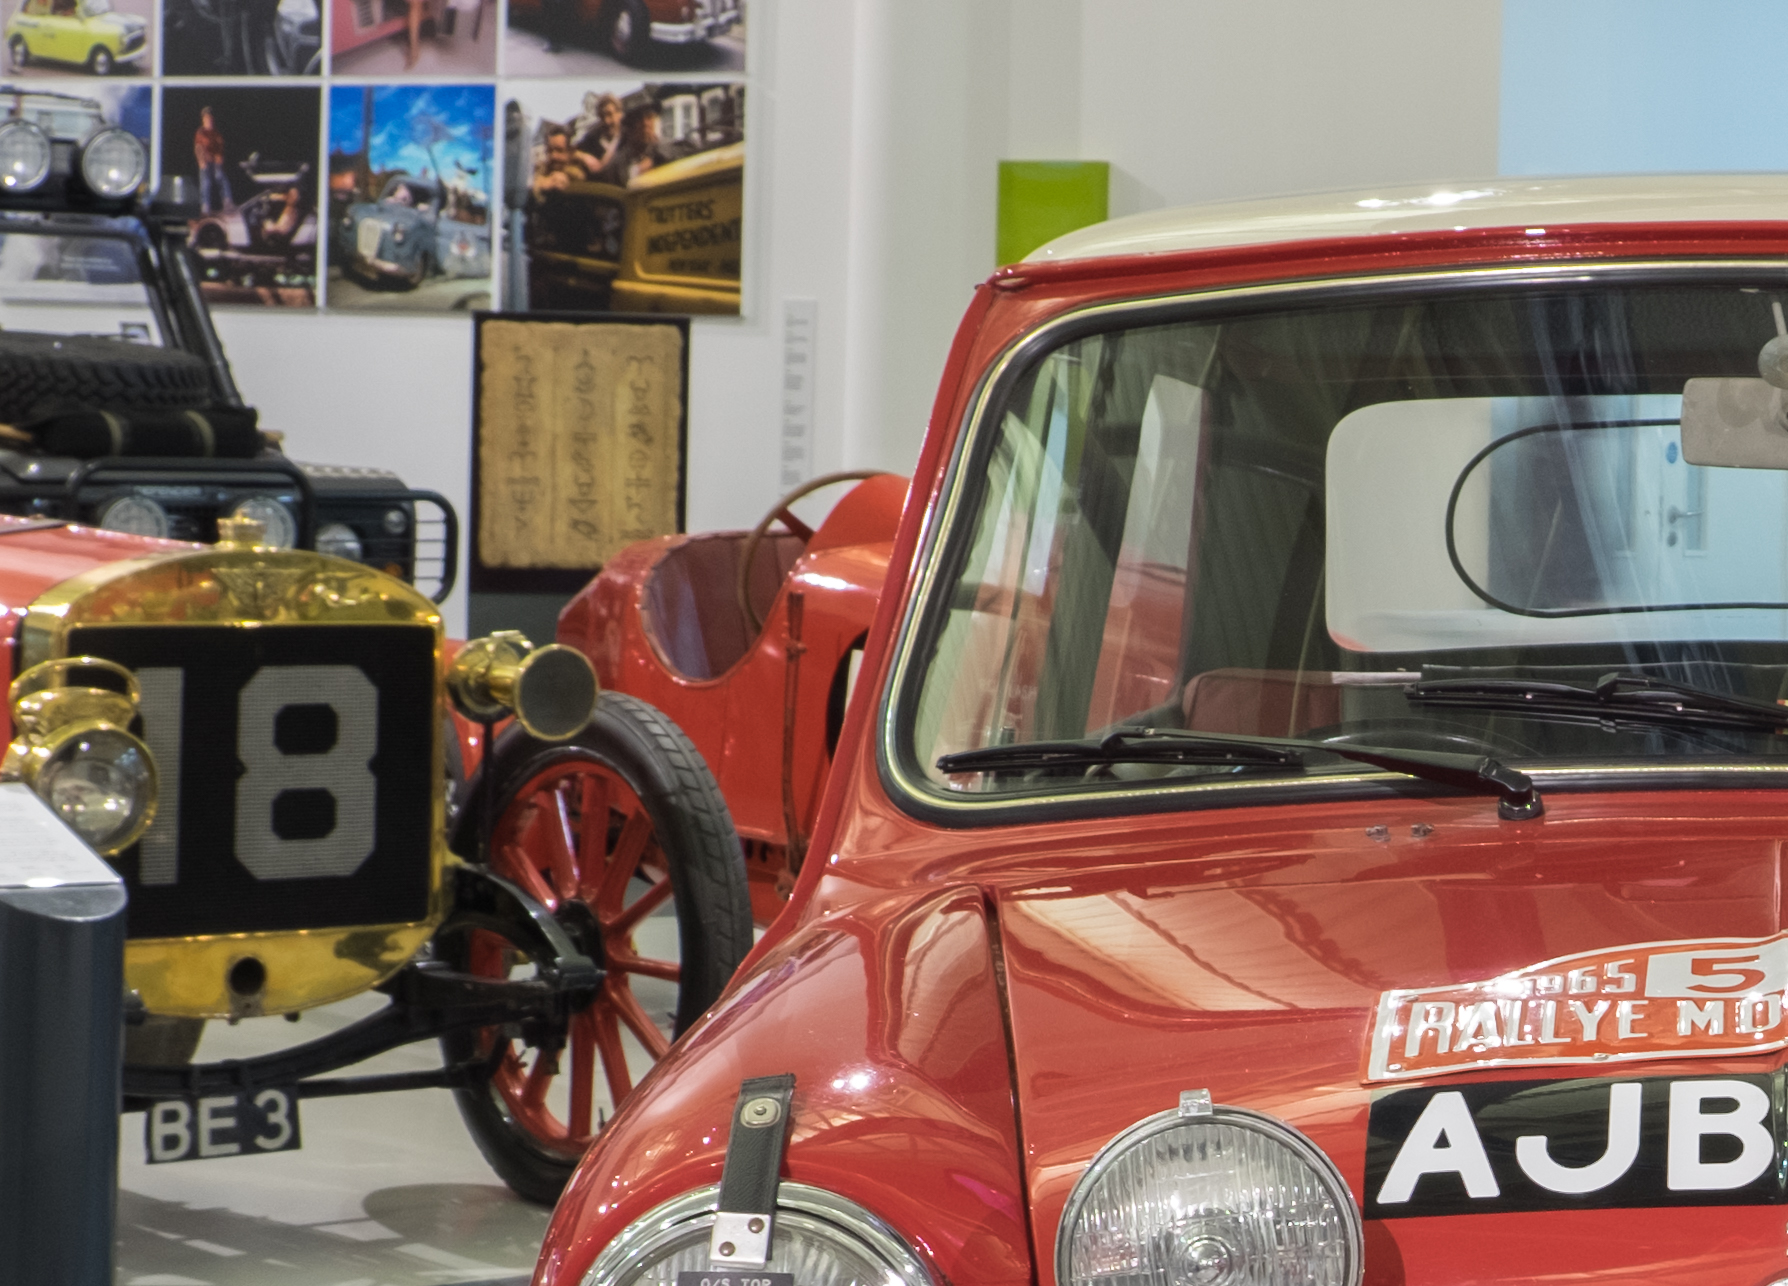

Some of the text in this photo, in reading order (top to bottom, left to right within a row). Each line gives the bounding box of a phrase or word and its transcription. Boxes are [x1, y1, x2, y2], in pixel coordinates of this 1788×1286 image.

[136, 664, 379, 885] 18
[1404, 999, 1650, 1058] RALLYE
[152, 1089, 292, 1162] BE 3
[1376, 1080, 1776, 1204] AJB
